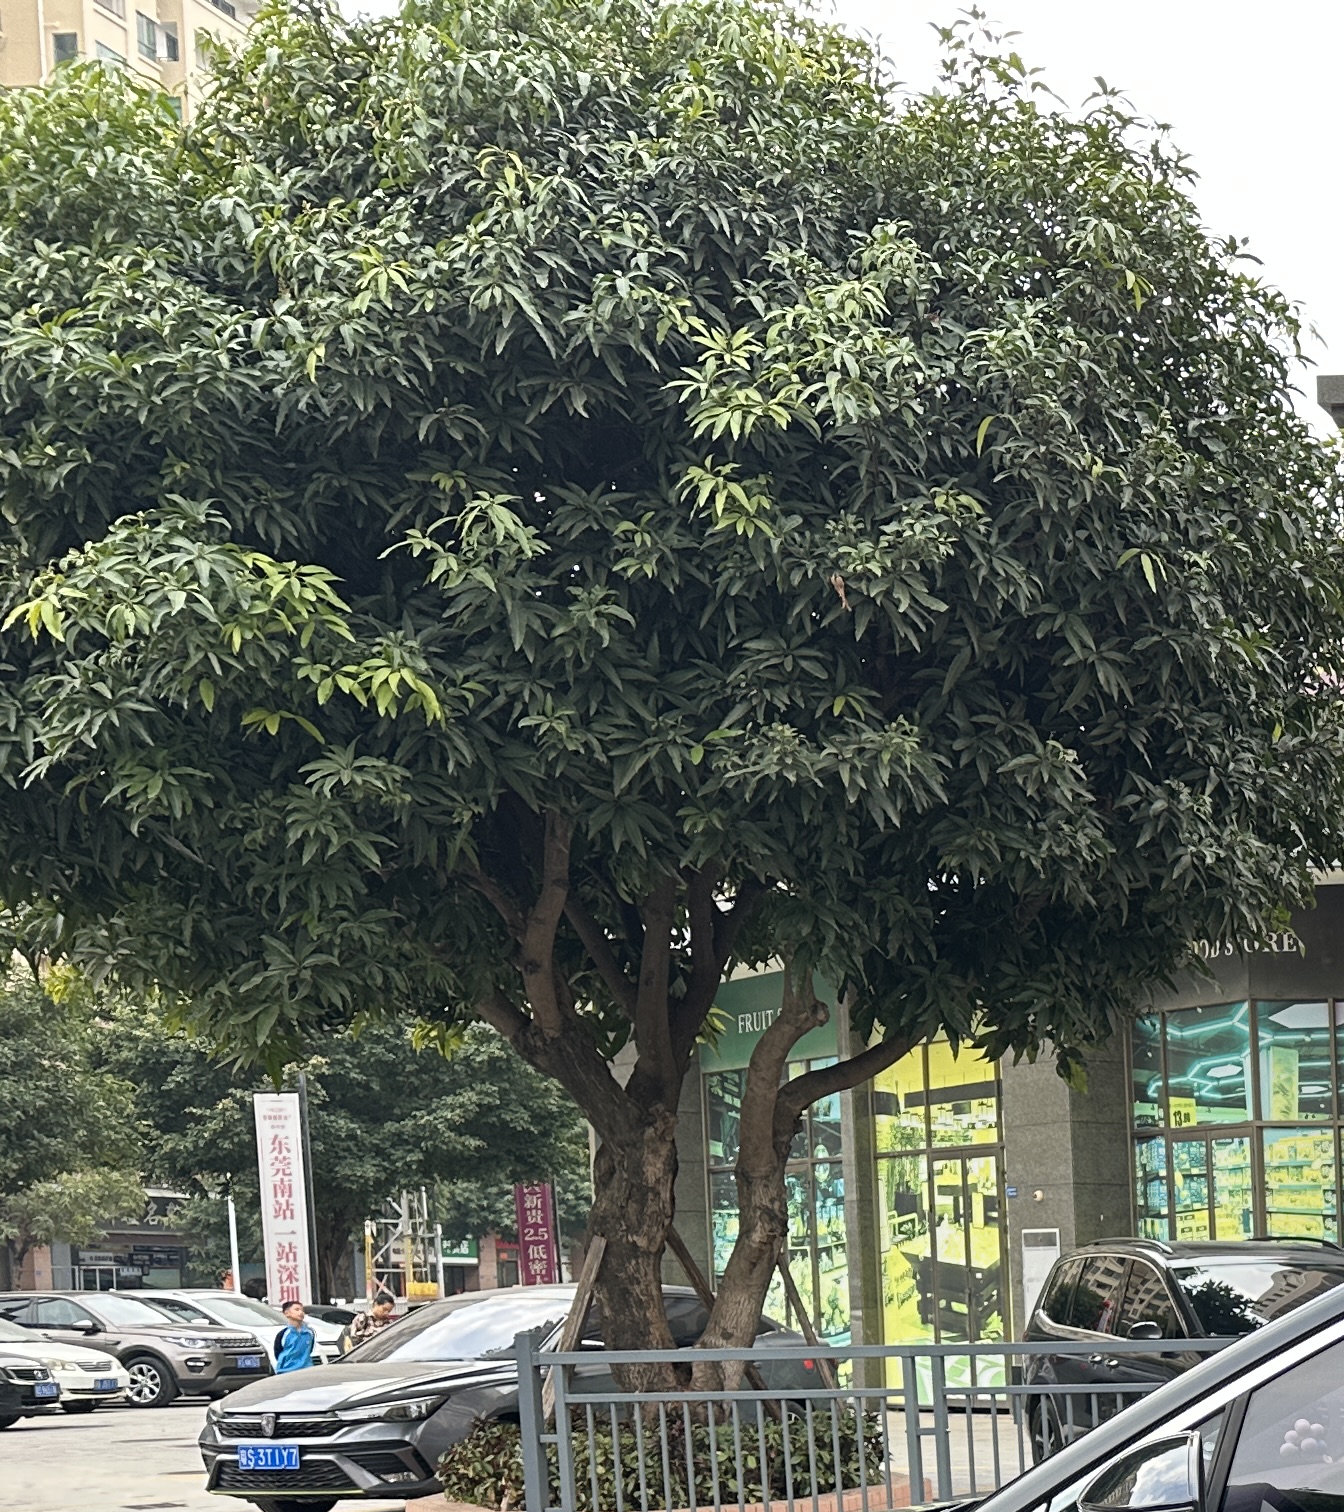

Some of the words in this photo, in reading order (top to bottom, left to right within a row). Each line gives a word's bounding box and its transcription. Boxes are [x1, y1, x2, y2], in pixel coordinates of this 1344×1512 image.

[738, 1009, 774, 1034] FRUIT
[269, 1133, 295, 1220] 东莞南站
[274, 1230, 301, 1303] 一站深圳
